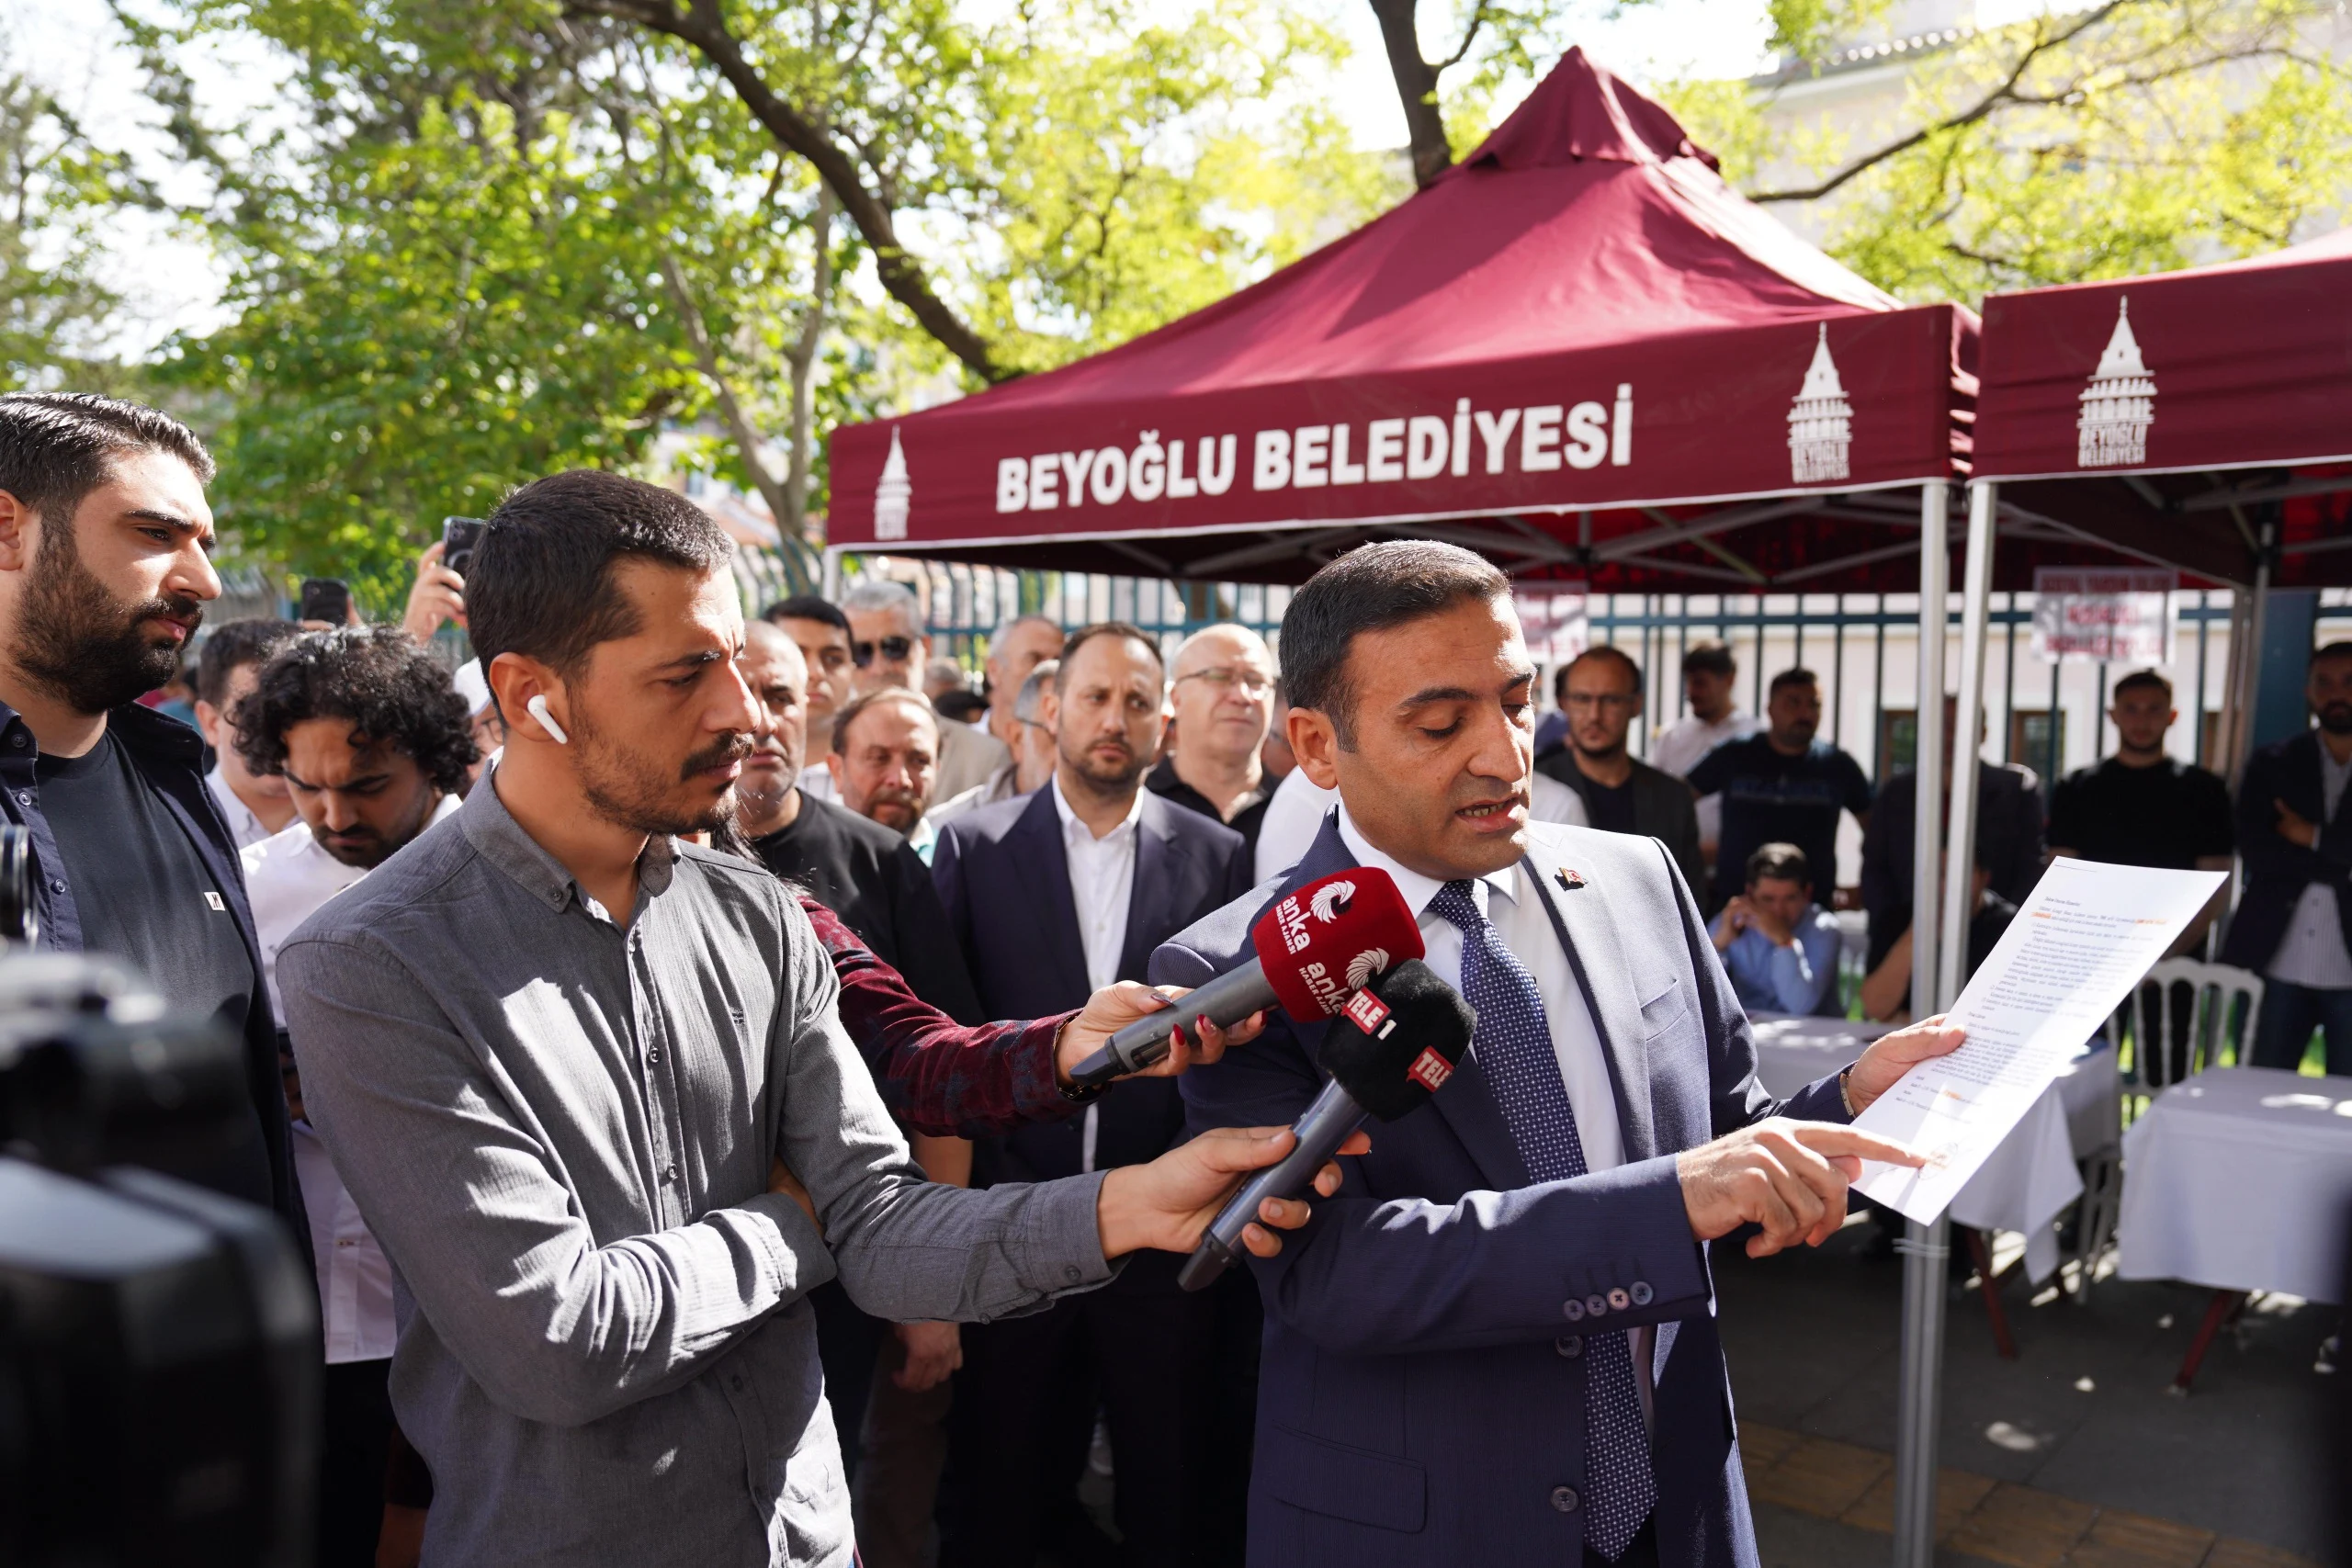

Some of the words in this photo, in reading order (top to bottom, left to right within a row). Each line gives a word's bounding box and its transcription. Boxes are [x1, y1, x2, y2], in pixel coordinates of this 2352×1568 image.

[996, 429, 1238, 513] BEYOĞLU
[1253, 382, 1633, 491] BELEDİYESİ
[1275, 904, 1286, 926] HABER
[1282, 896, 1311, 952] anka
[1298, 967, 1319, 995] HABER
[1346, 989, 1385, 1029] TELE
[1377, 1019, 1396, 1041] 1
